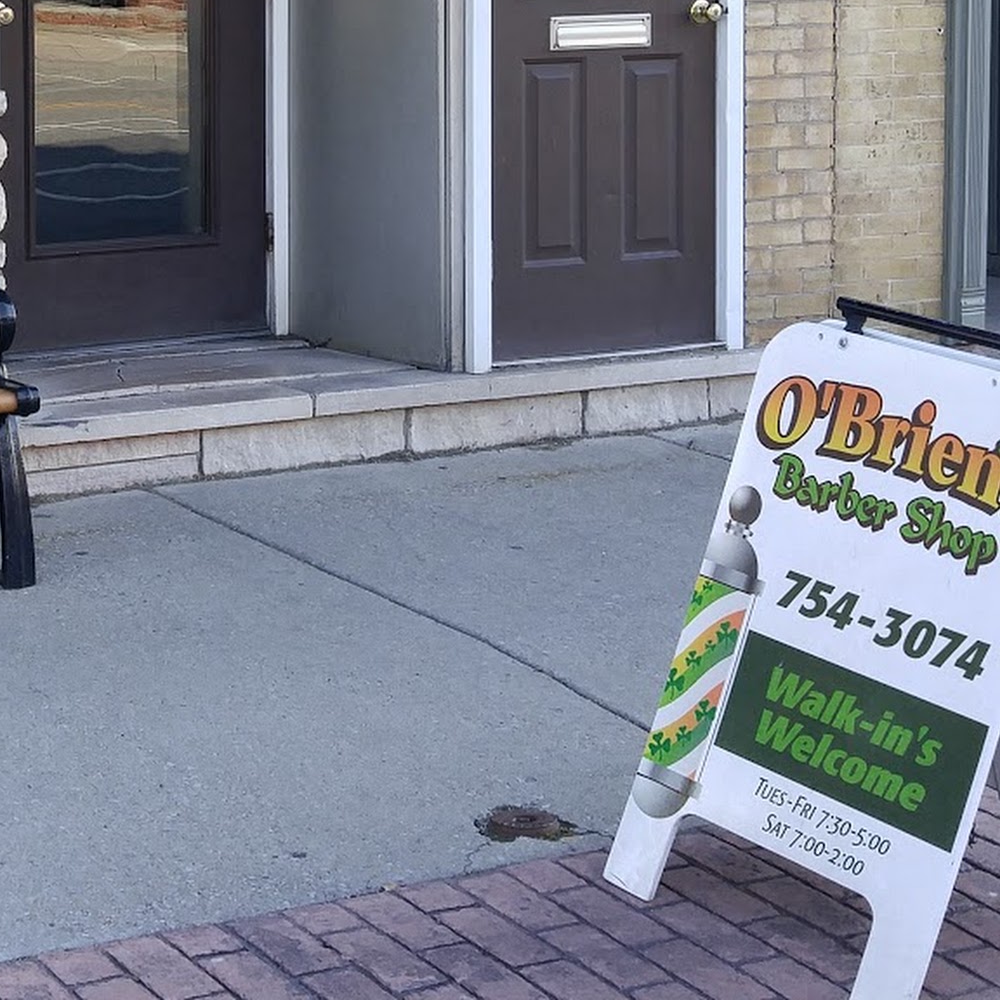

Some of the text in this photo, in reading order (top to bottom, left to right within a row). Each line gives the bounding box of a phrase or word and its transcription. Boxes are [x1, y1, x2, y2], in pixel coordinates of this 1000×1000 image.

[756, 375, 1000, 515] O'Brien
[773, 452, 998, 576] Barber Shop
[776, 570, 991, 681] 754-3074
[754, 708, 927, 812] Welcome
[765, 664, 943, 767] Walk-in's
[789, 829, 866, 876] 7:00-2:00
[814, 810, 892, 856] 7:30-5:00
